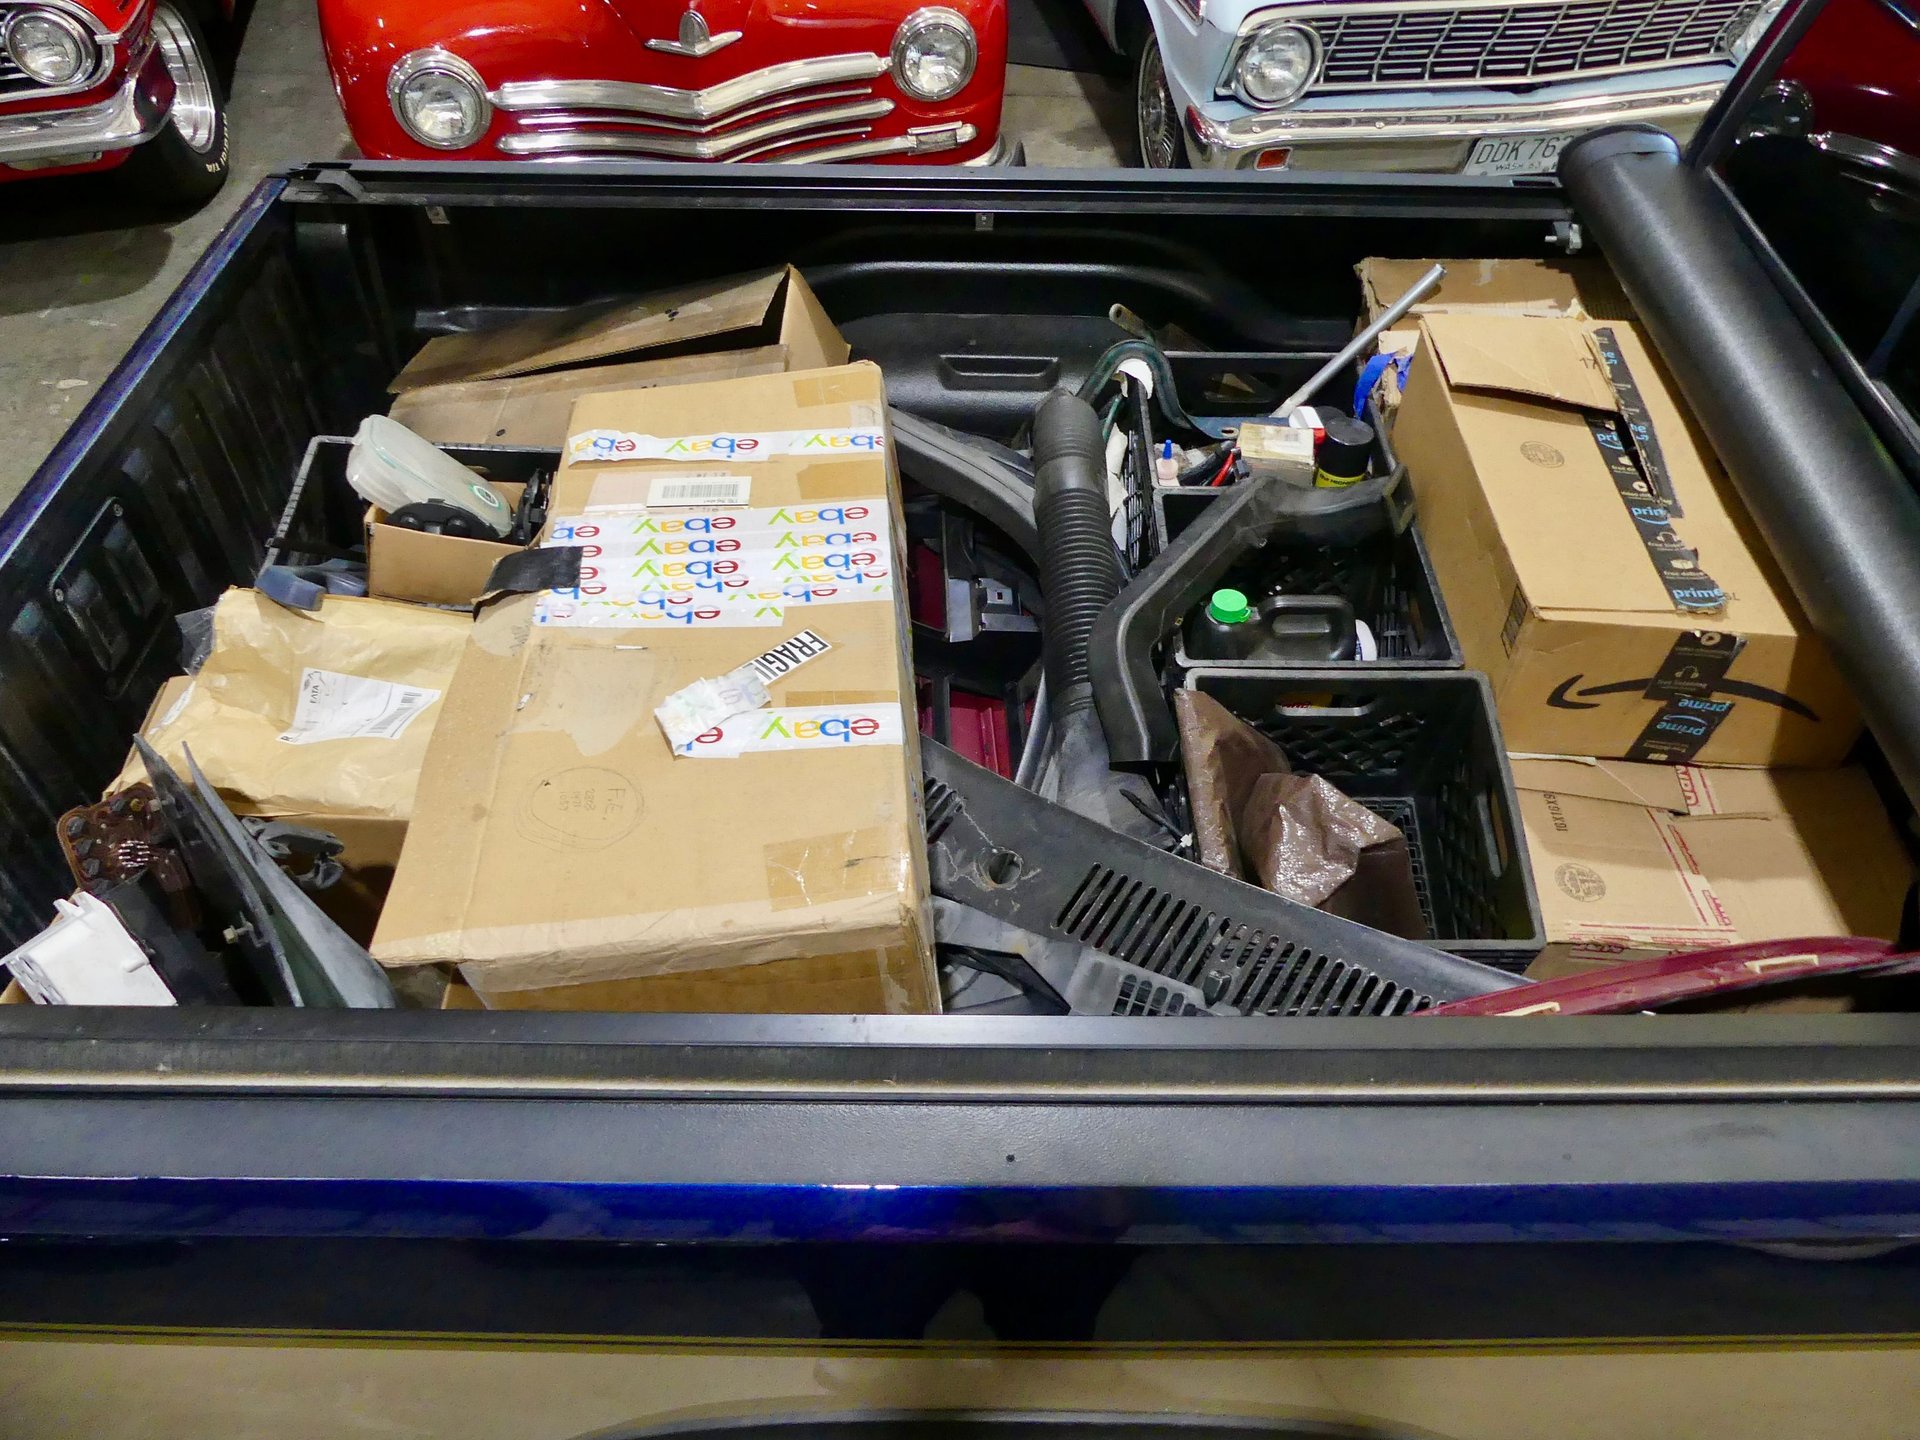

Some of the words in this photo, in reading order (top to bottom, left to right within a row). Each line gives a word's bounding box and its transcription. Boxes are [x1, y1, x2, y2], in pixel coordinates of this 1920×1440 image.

[1475, 141, 1526, 164] DDK
[574, 438, 637, 453] eba
[665, 437, 759, 454] ebay
[768, 506, 869, 524] ebay
[551, 525, 600, 540] eb
[633, 517, 736, 534] ebay
[635, 538, 741, 554] ebay
[774, 531, 877, 549] ebay
[632, 559, 739, 579] ebay
[772, 552, 876, 571] ebay
[1673, 588, 1724, 600] prime
[742, 630, 828, 682] FRAGIL
[1678, 698, 1730, 712] prime
[760, 713, 880, 742] ebay
[1656, 721, 1705, 736] prime
